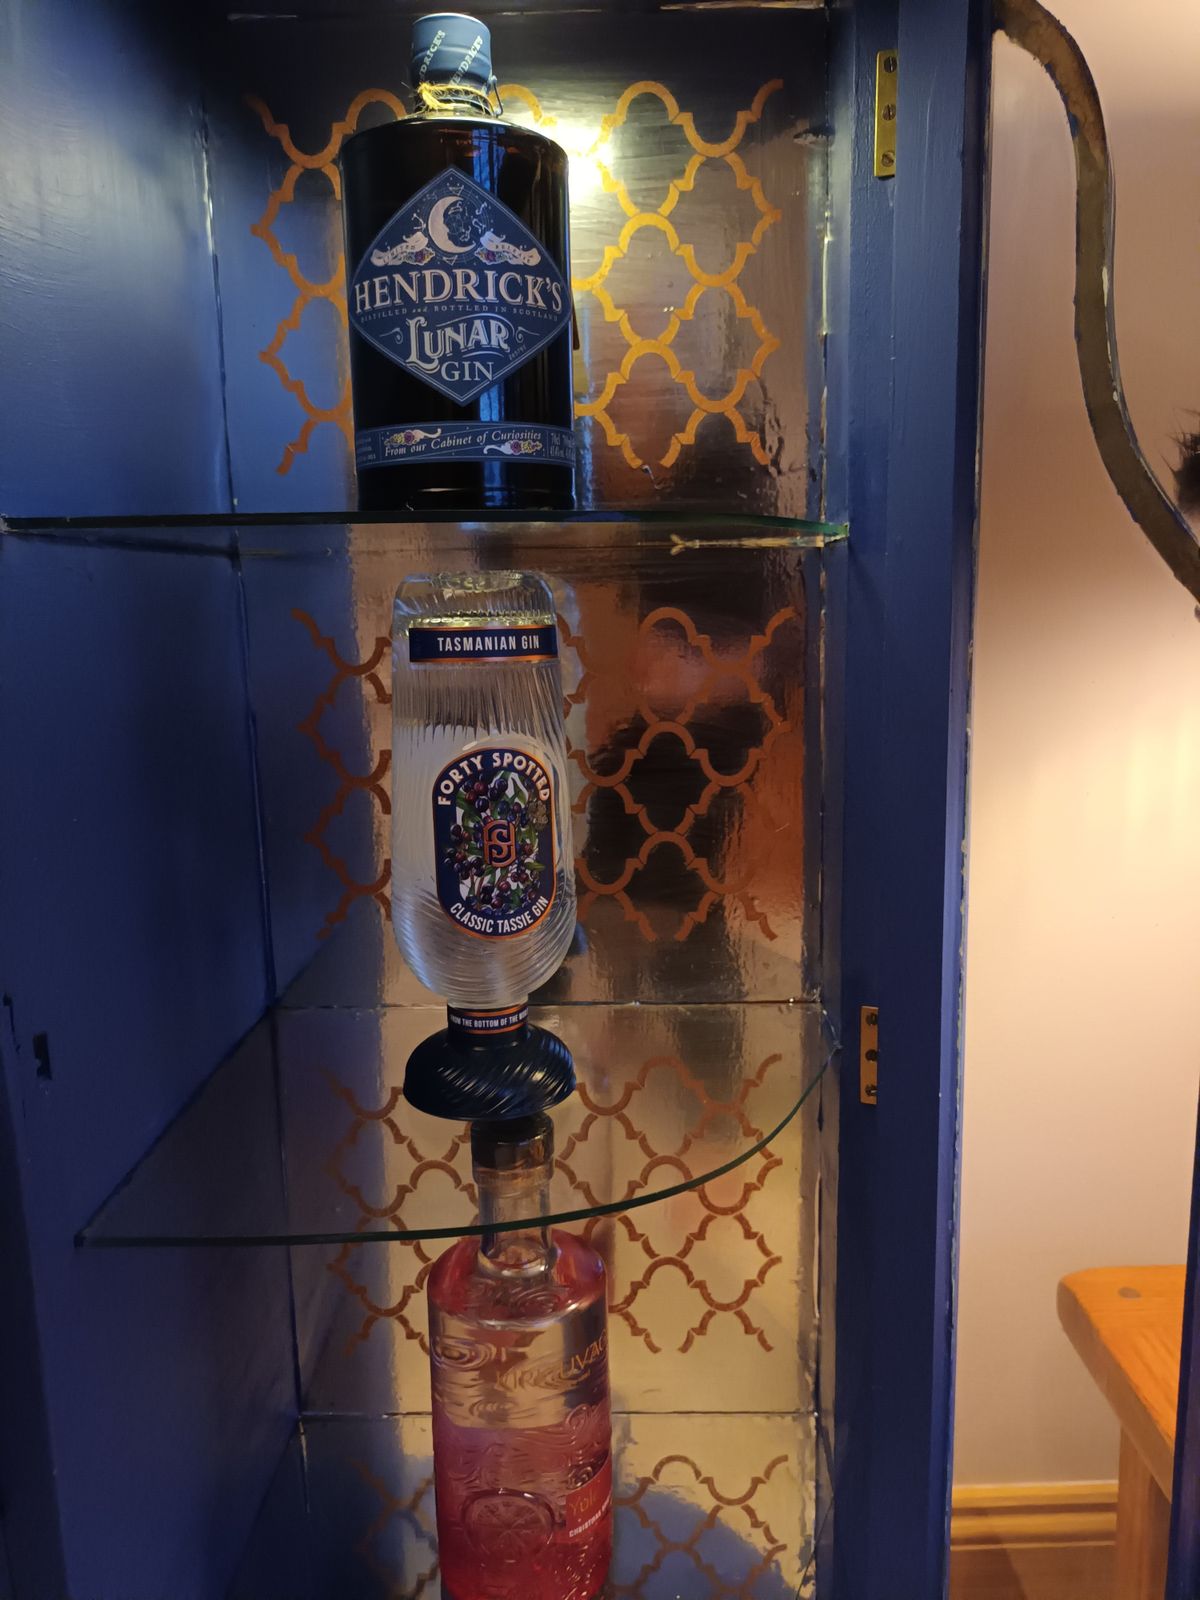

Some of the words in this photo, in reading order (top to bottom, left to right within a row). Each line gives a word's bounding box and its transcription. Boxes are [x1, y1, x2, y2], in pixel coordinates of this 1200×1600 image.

[354, 268, 563, 314] HENDRICK'S
[433, 304, 489, 313] BOTTLED
[495, 305, 507, 313] IN
[512, 307, 558, 321] SCOTLAND
[405, 315, 511, 374] LUNAR
[440, 361, 495, 382] GIN
[384, 445, 407, 457] From
[410, 443, 427, 452] our
[430, 435, 472, 450] Cabinet
[476, 431, 489, 446] of
[491, 429, 542, 442] Curiosities
[437, 635, 517, 652] TASMANIAN
[521, 635, 540, 650] GIN
[437, 754, 485, 806] FORTY
[492, 752, 551, 801] SPOTTED
[450, 901, 494, 934] CLASSIC
[497, 911, 534, 933] TASSIE
[534, 895, 549, 917] GIN
[462, 1018, 473, 1028] THE
[474, 1019, 499, 1029] BOTTOM
[500, 1018, 508, 1027] OF
[509, 1014, 519, 1025] THE
